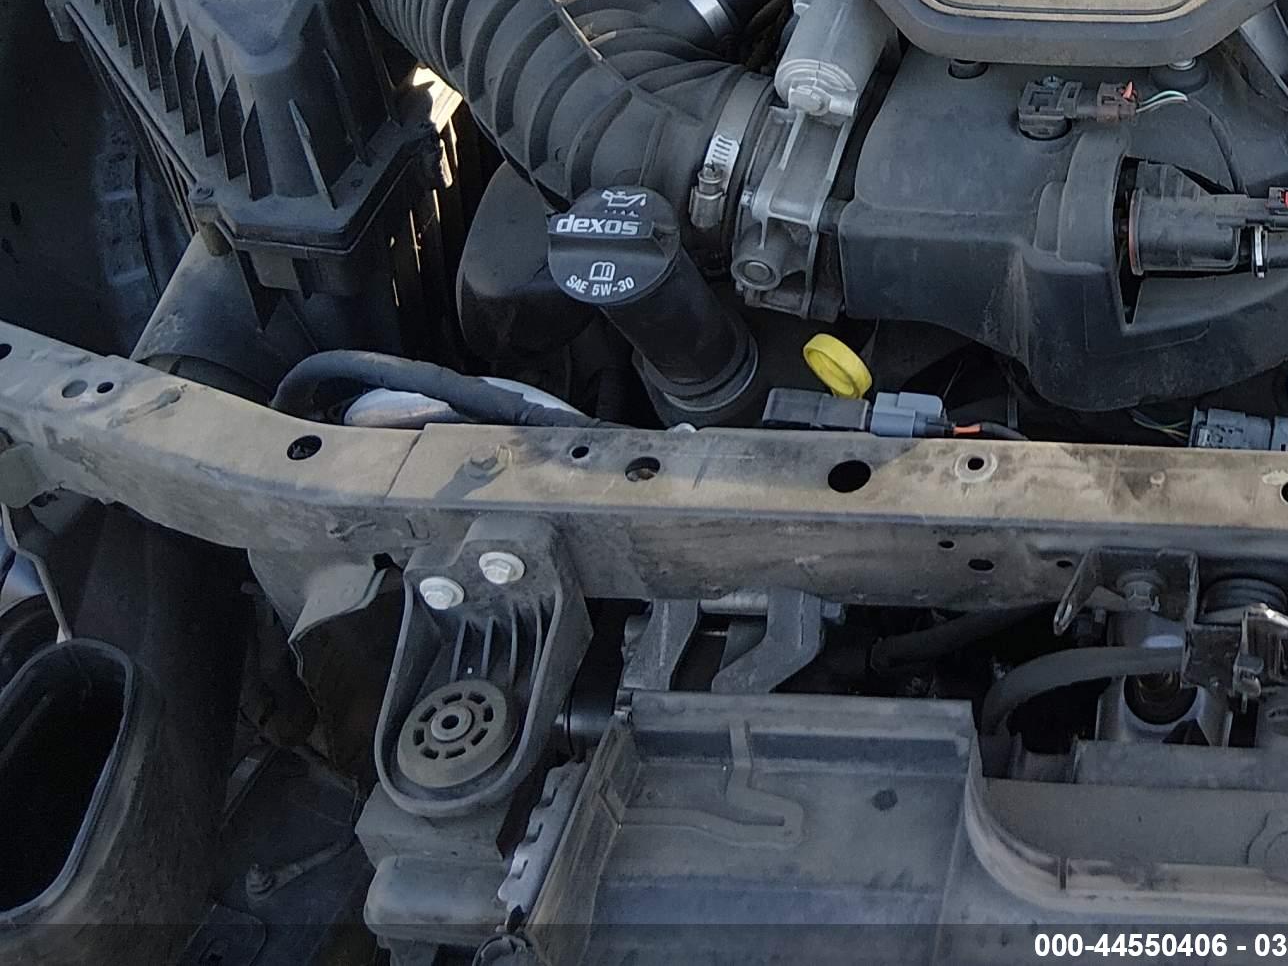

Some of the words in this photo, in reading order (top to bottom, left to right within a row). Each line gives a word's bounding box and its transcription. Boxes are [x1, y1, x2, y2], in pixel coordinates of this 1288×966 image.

[556, 213, 641, 236] dexos
[565, 274, 590, 293] SAE
[591, 276, 636, 297] 5W-30
